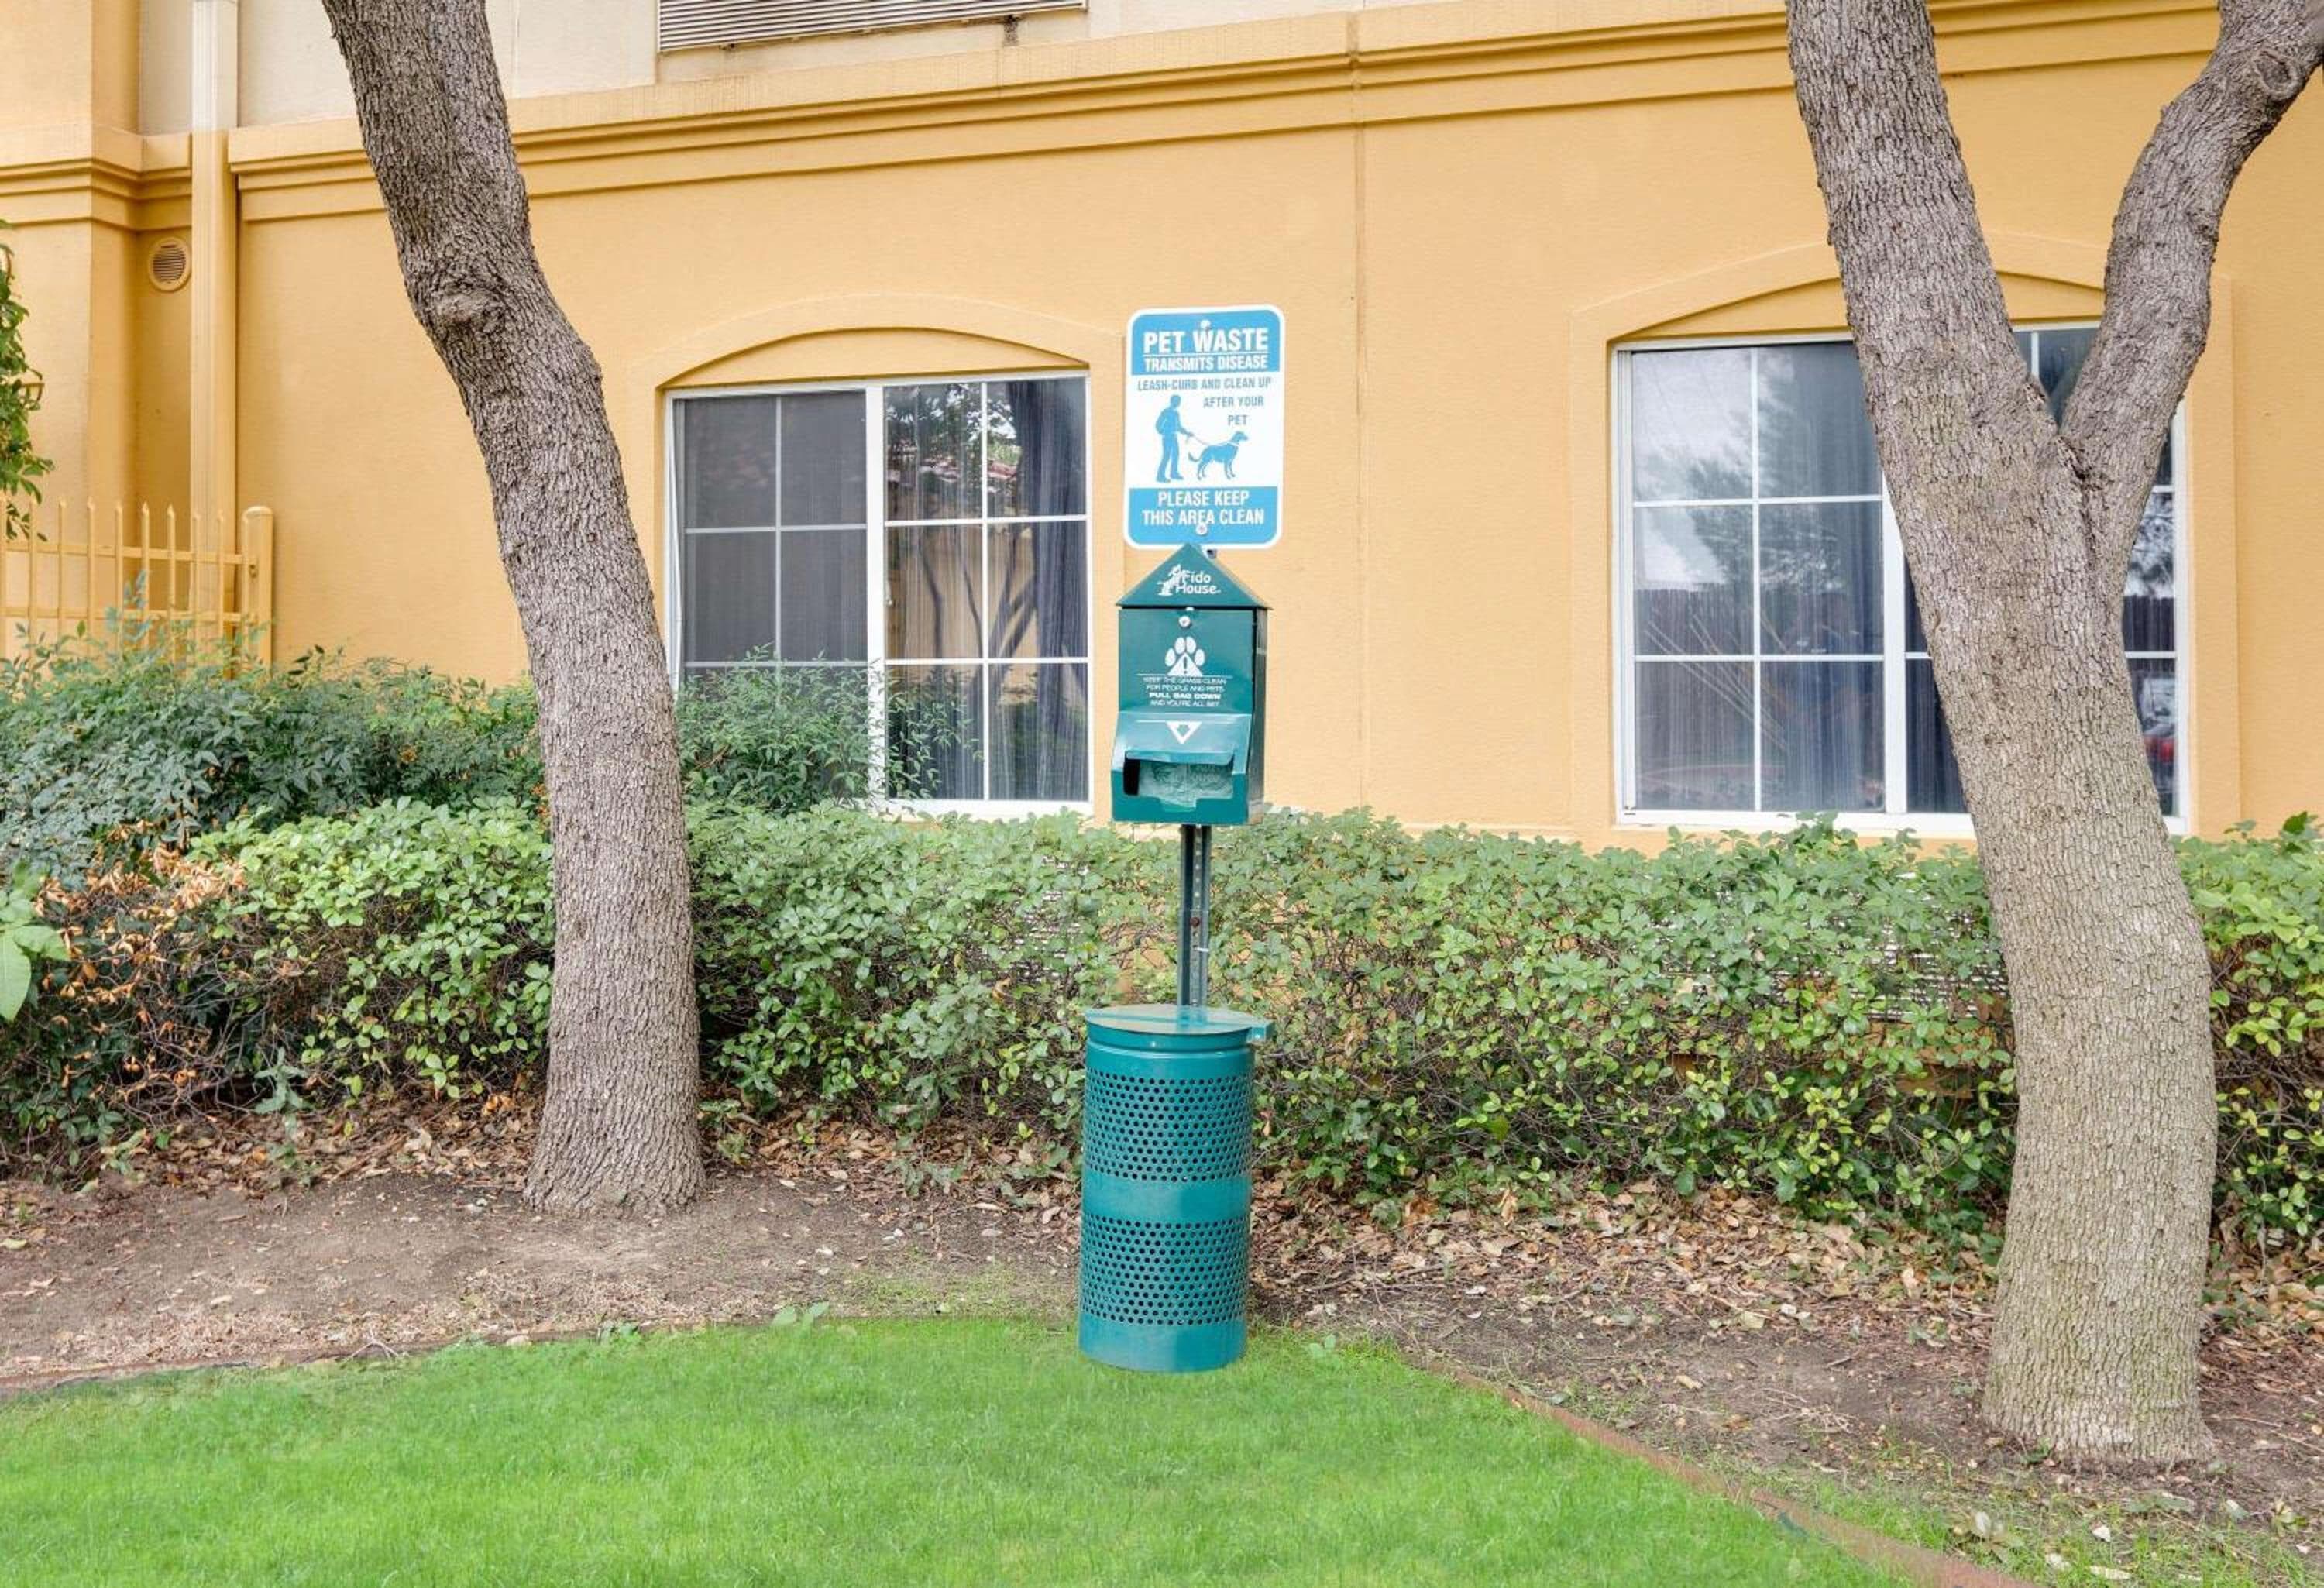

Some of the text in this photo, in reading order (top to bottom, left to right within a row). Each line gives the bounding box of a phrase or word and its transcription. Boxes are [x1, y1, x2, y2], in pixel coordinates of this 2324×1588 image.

[1143, 328, 1268, 353] PET WASTE
[1145, 355, 1268, 372] TRANSMITS DISEASE
[1138, 376, 1271, 390] LEASH-CURB AND CLEAN UP
[1203, 396, 1264, 407] AFTER YOUR
[1228, 414, 1247, 425] PET
[1158, 490, 1250, 507] PLEASE KEEP
[1142, 508, 1265, 525] THIS AREA CLEAN
[1182, 570, 1211, 583] Fido
[1176, 583, 1217, 594] House
